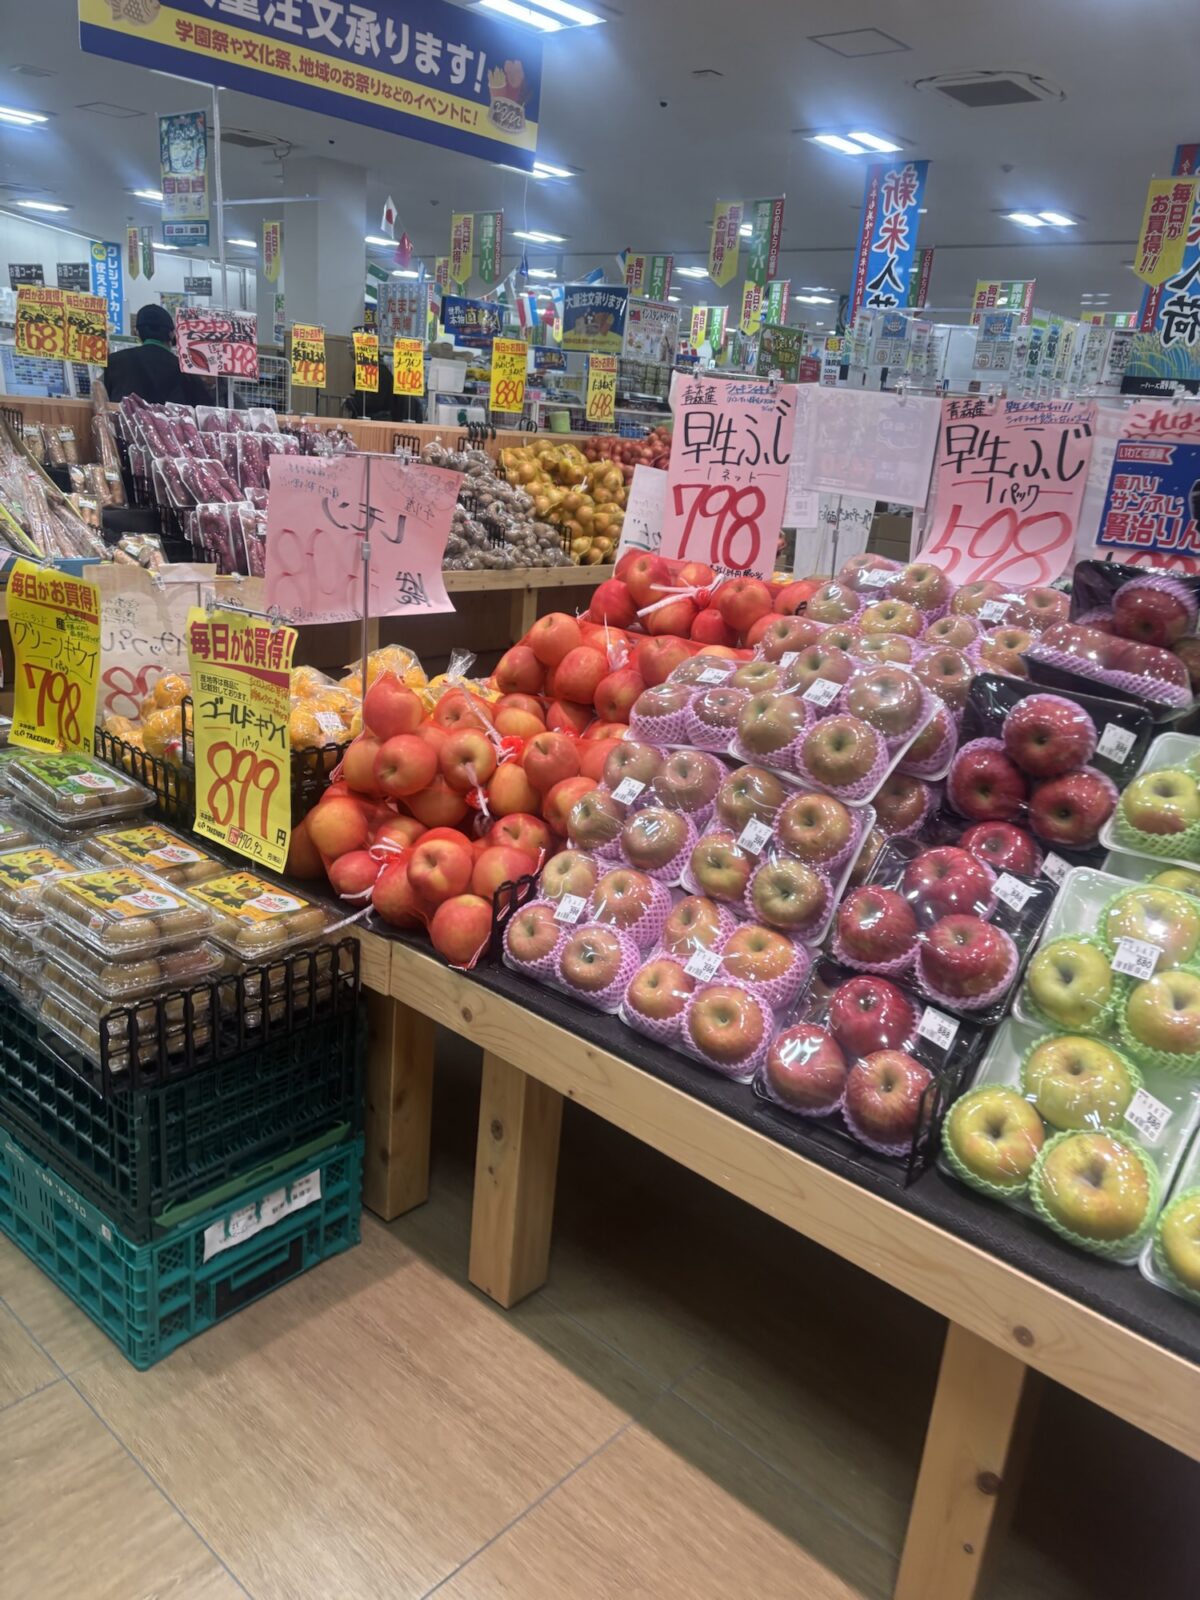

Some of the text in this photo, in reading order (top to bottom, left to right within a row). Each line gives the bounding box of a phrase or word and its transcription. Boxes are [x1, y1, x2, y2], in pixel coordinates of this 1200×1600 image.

[208, 0, 487, 93] 量注文承ります!
[175, 19, 478, 126] 学園祭や文化祭、地域のお祭りなどのイベントに!
[727, 206, 740, 250] 毎日が
[1139, 194, 1171, 273] お買得!!
[1168, 183, 1193, 240] 毎日が
[712, 215, 727, 276] お買得!!
[387, 298, 418, 313] たまご
[565, 292, 627, 316] 大量注文承ります!
[26, 322, 57, 353] 68
[496, 380, 524, 405] 880
[947, 399, 986, 419] 青森産
[681, 398, 792, 466] 早生ふじ
[941, 424, 1092, 482] 早生ふじ
[986, 477, 1040, 513] 1パック
[1111, 492, 1184, 516] サンふじ
[673, 484, 766, 570] 798
[1103, 513, 1200, 550] 賢治りん
[11, 571, 99, 615] 毎日がお買得!
[14, 621, 98, 679] グリーンキウイ
[190, 621, 295, 670] 毎日がお買得!
[22, 662, 82, 746] 798
[199, 696, 287, 750] ゴールドキウイ
[83, 737, 91, 753] 円
[206, 741, 281, 840] 899
[239, 831, 263, 857] 970.92
[276, 828, 287, 847] 円
